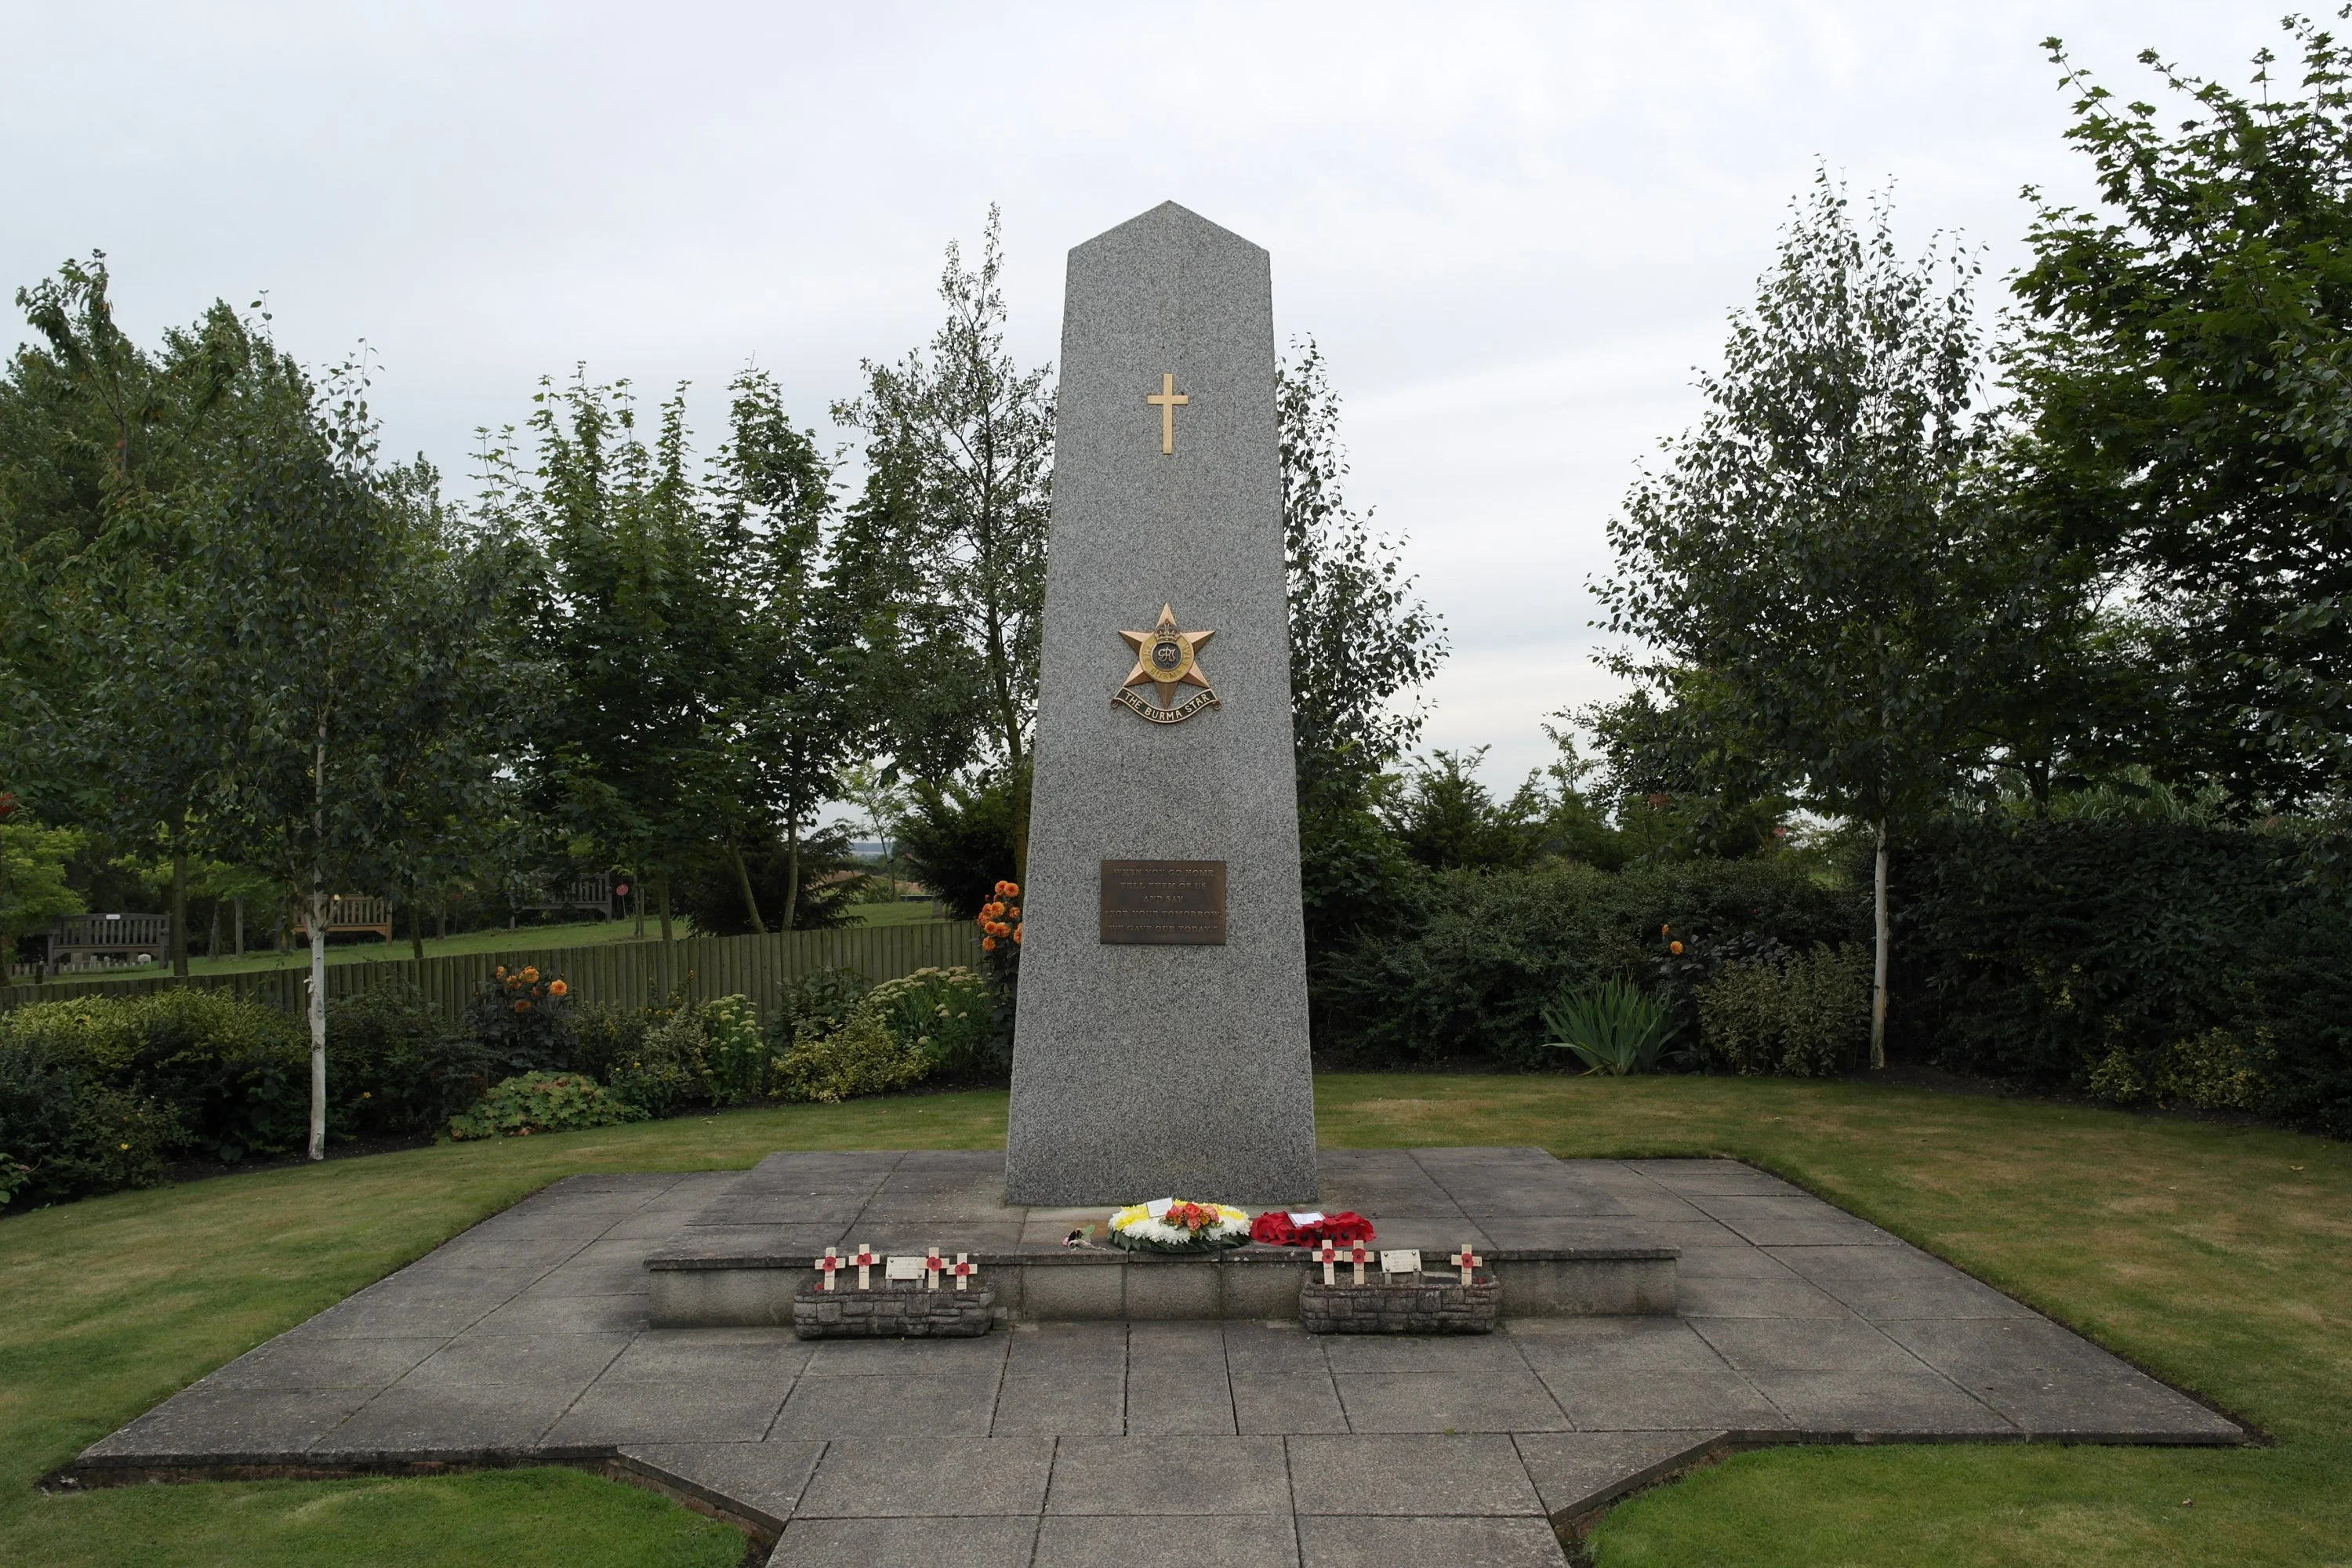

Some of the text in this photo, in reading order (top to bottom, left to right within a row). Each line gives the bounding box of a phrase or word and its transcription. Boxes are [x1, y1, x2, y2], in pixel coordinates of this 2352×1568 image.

[1125, 691, 1210, 721] THE BURMA STAR
[1185, 869, 1214, 877] HOME
